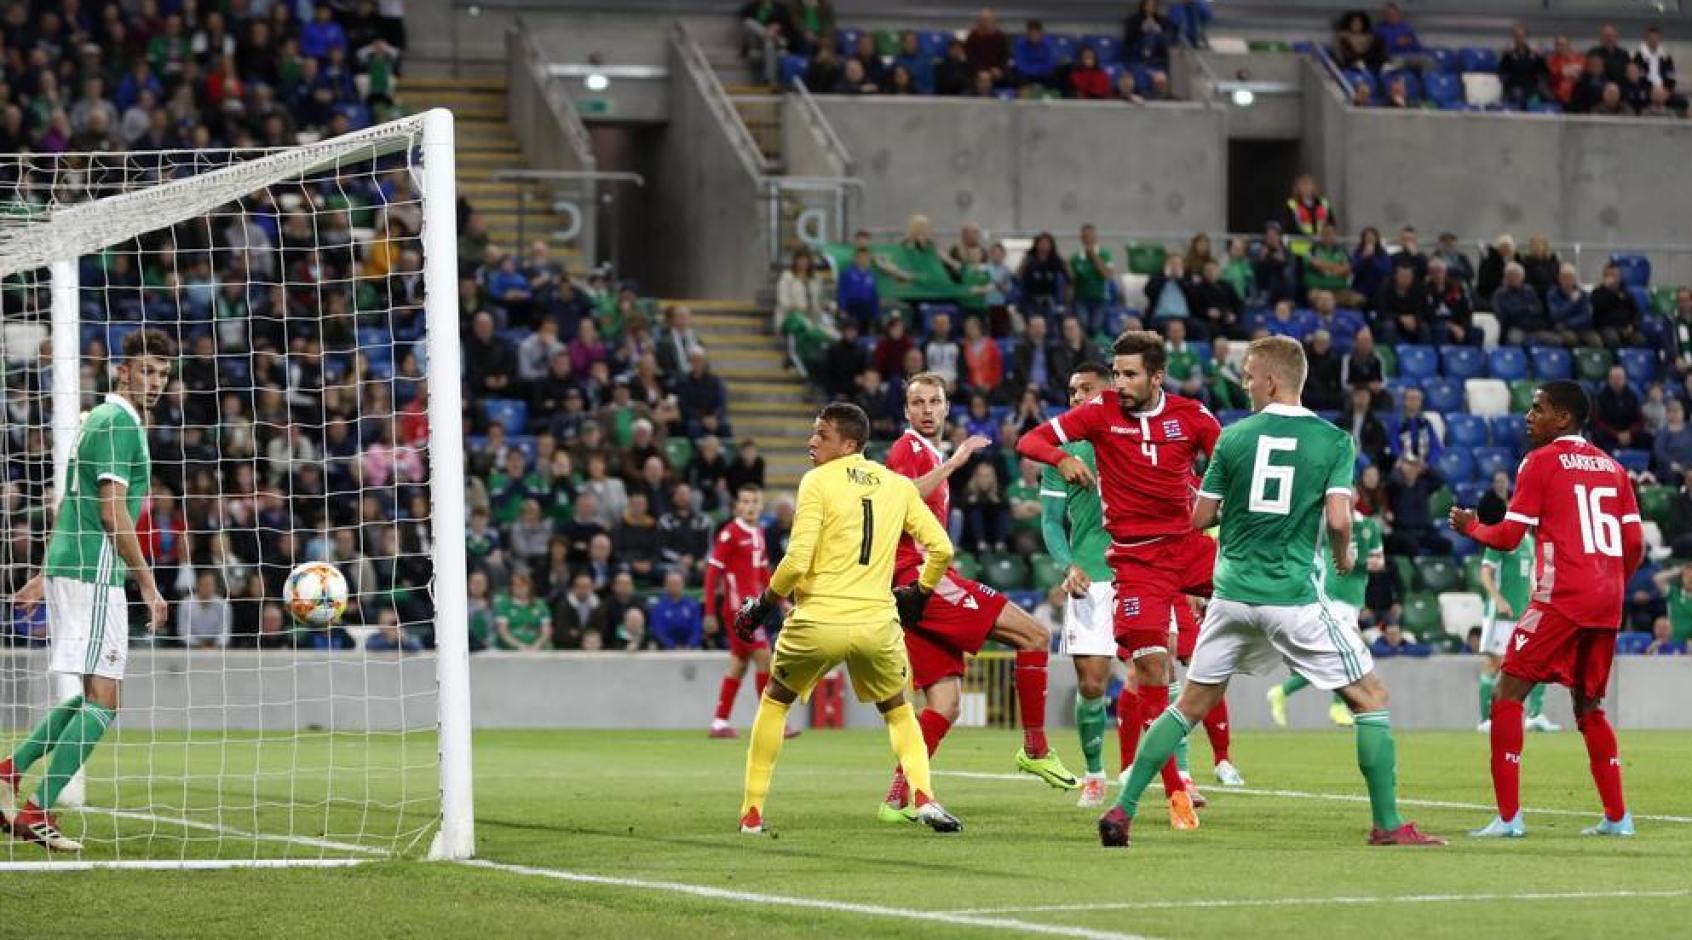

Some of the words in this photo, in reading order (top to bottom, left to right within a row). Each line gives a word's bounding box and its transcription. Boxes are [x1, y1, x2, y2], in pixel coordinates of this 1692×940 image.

[1140, 441, 1158, 467] 4
[1247, 434, 1298, 515] 6
[859, 497, 874, 566] 1
[1573, 483, 1623, 557] 16
